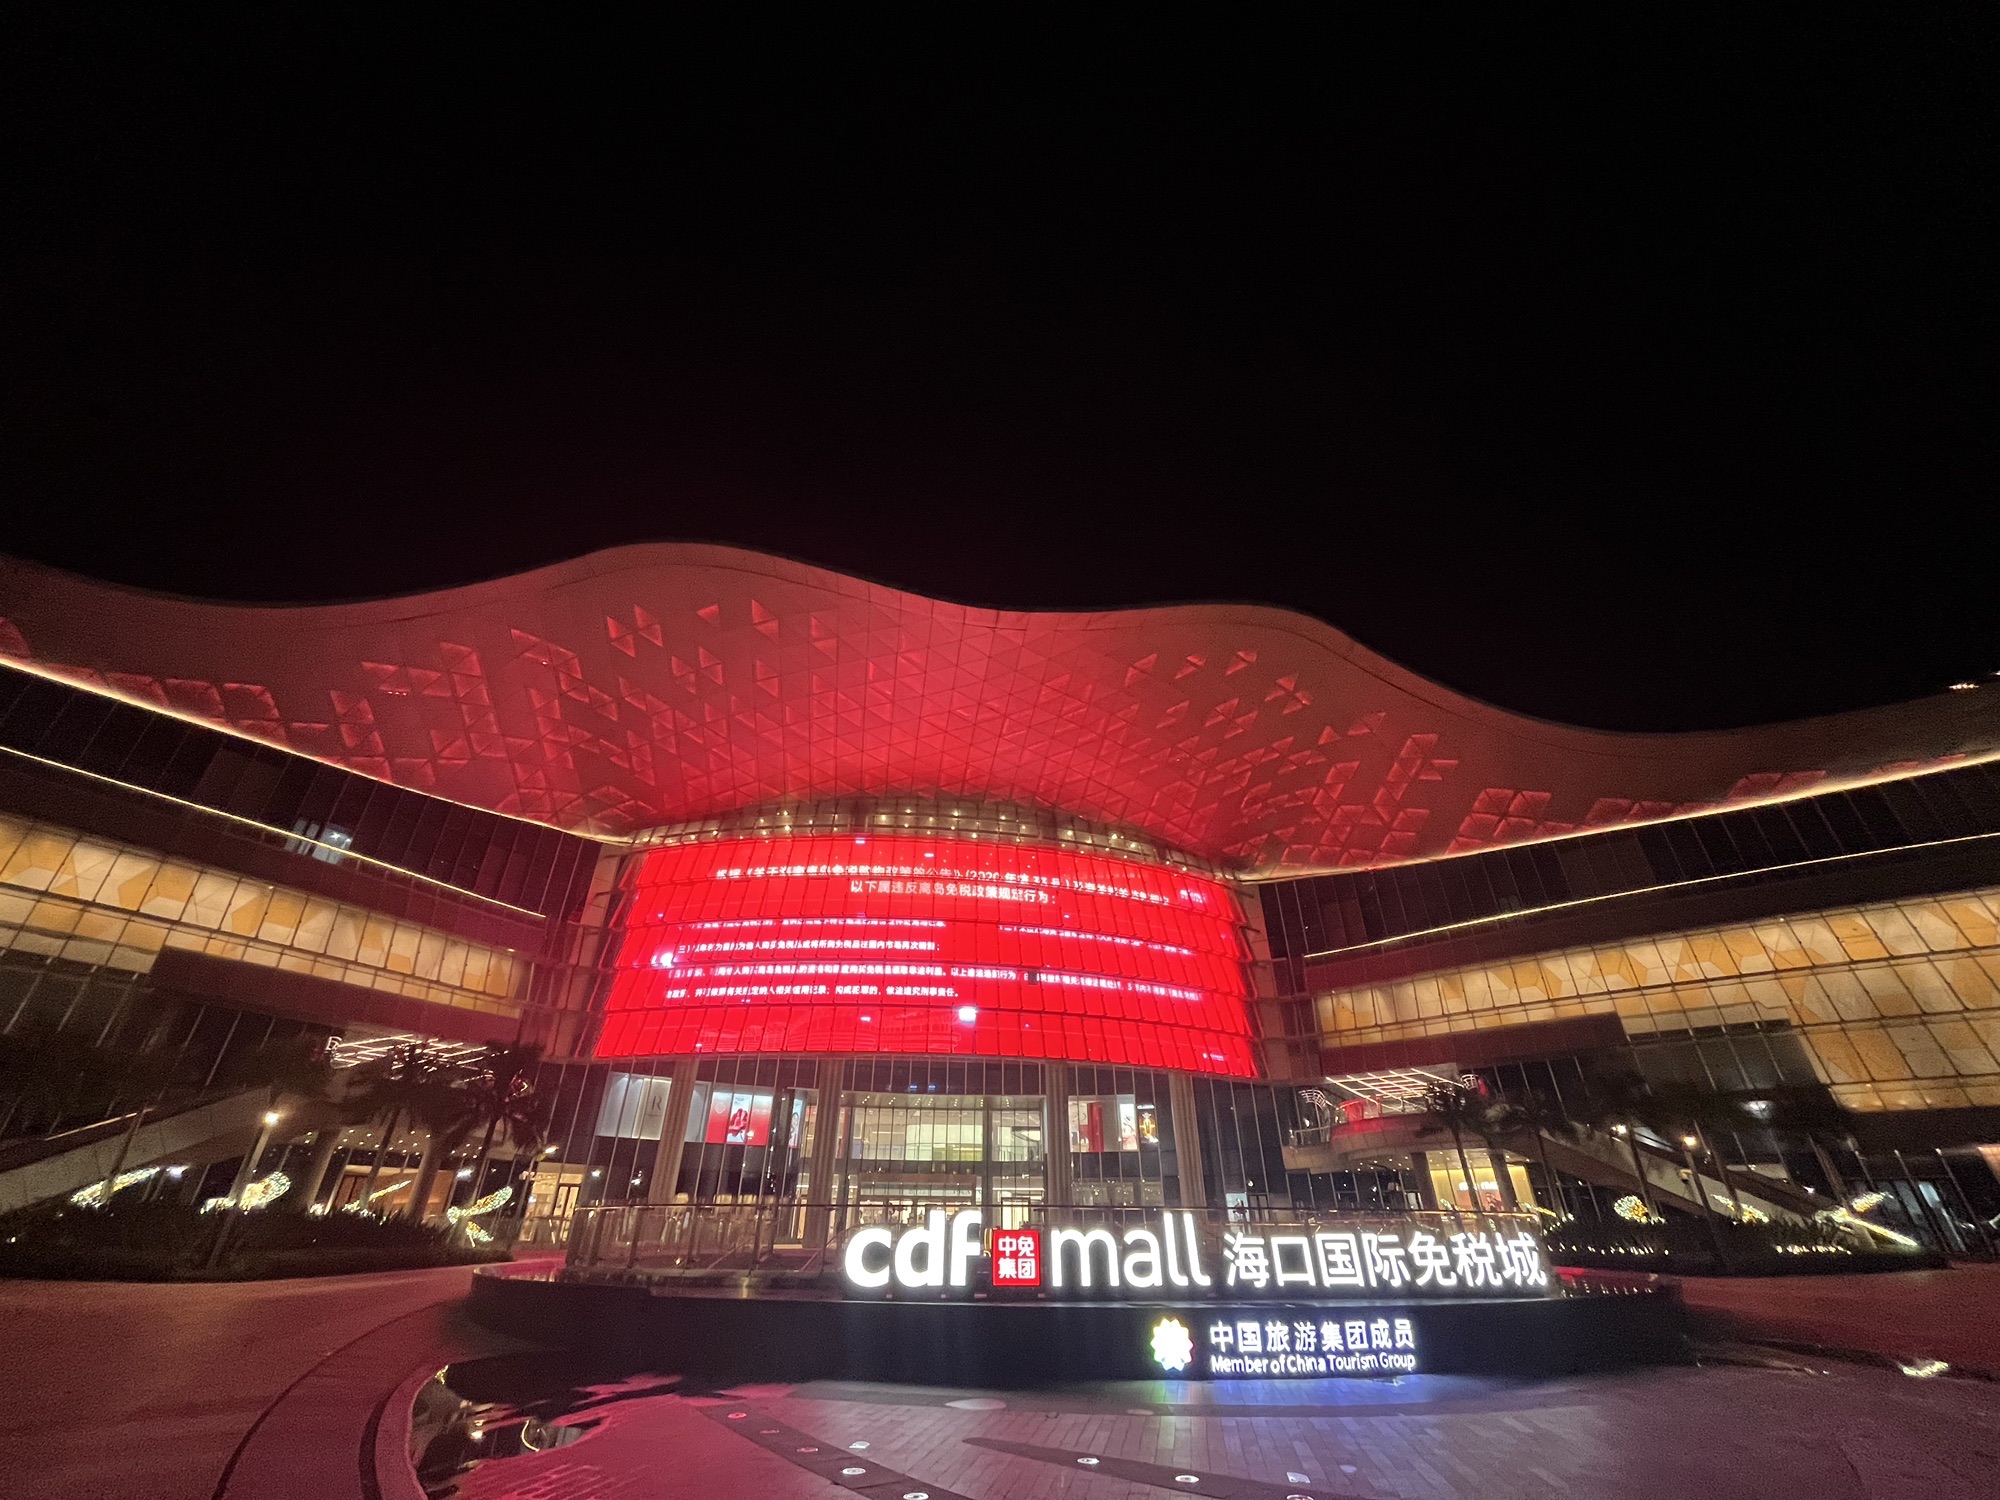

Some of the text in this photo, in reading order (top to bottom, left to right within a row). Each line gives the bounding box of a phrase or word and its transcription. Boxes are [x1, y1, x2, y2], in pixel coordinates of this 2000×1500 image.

[843, 1210, 983, 1288] cdf
[998, 1236, 1035, 1257] 中免
[1050, 1211, 1211, 1288] mall
[1222, 1231, 1549, 1288] 海口国际免税城
[998, 1257, 1036, 1279] 集团
[1209, 1318, 1415, 1353] 中国旅游集团成员
[1210, 1351, 1416, 1374] Member of China Tourism Group
